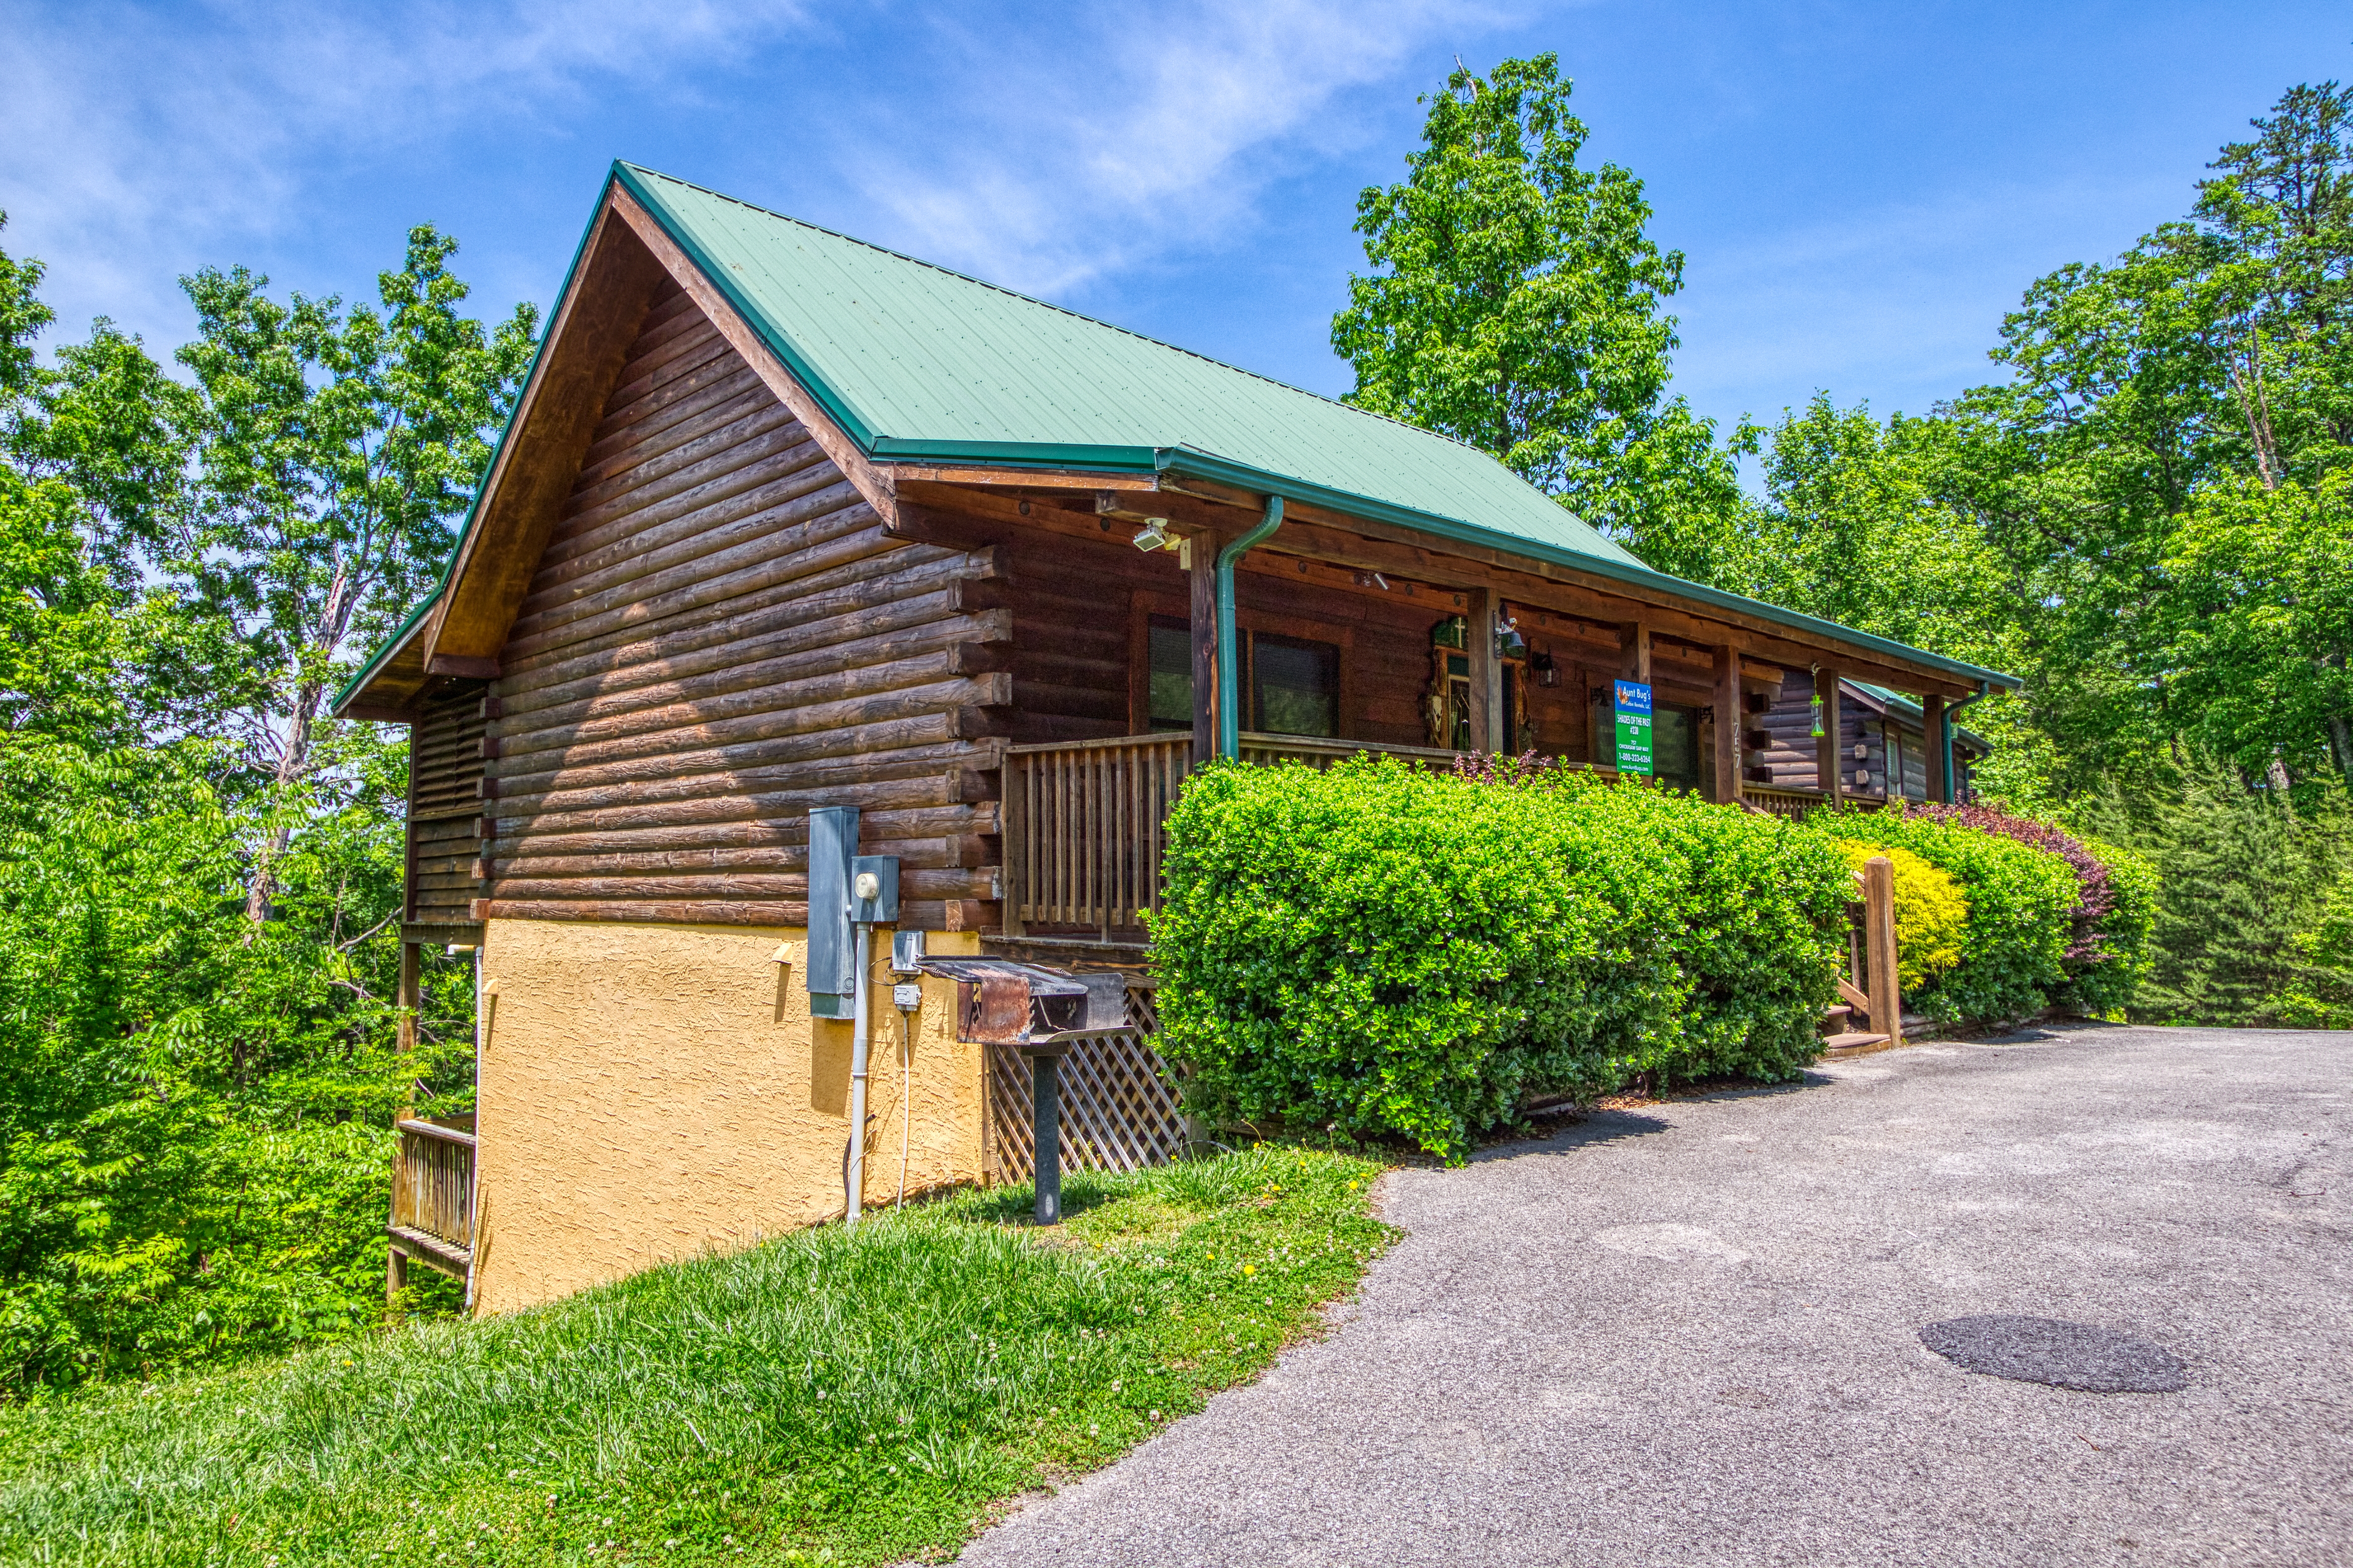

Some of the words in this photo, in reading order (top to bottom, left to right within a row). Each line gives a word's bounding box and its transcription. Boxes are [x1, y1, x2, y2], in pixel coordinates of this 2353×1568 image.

[1623, 686, 1635, 697] Aunt
[1637, 688, 1651, 702] Bug's
[1617, 714, 1630, 724] SHADES
[1630, 716, 1635, 725] OF
[1630, 726, 1638, 735] #230
[1619, 752, 1651, 763] 1-800-223-6264
